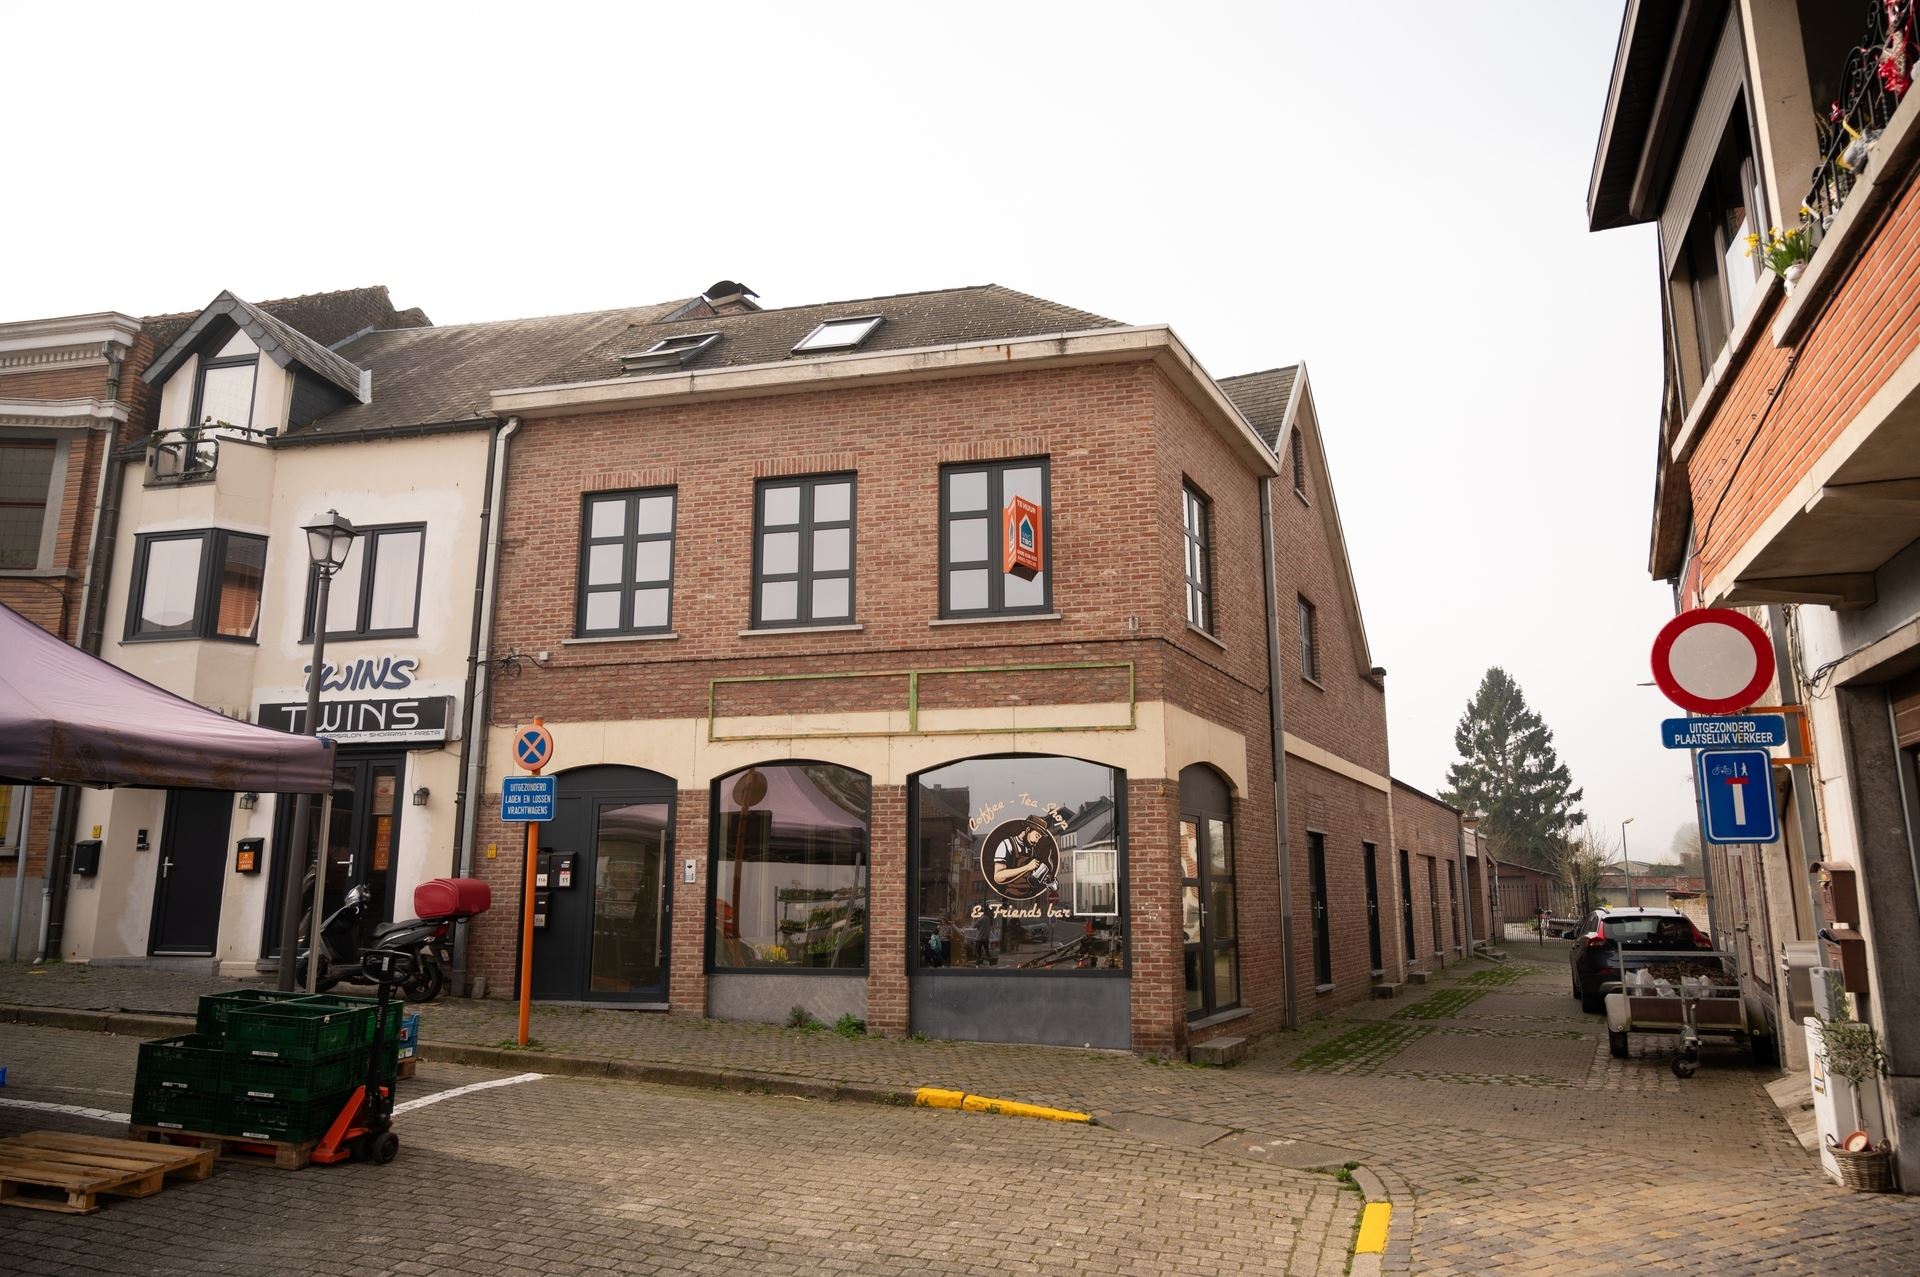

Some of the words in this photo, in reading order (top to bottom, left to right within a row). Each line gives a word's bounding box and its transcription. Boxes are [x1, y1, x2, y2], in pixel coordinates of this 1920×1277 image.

[1016, 500, 1023, 508] TE
[281, 701, 419, 732] TWINS
[1689, 721, 1756, 733] UITGEZONDERD
[1731, 732, 1773, 744] VERKEER
[510, 783, 547, 792] UITGEZONDERD
[505, 795, 521, 804] LADEN
[523, 795, 530, 803] EN
[532, 795, 551, 803] LOSSEN
[507, 806, 547, 815] VRACHTWAGENS
[968, 799, 1005, 831] Coffee
[1018, 792, 1039, 808] Tea
[1041, 802, 1069, 831] Shop
[988, 903, 1042, 918] Friends
[1047, 904, 1071, 918] bar
